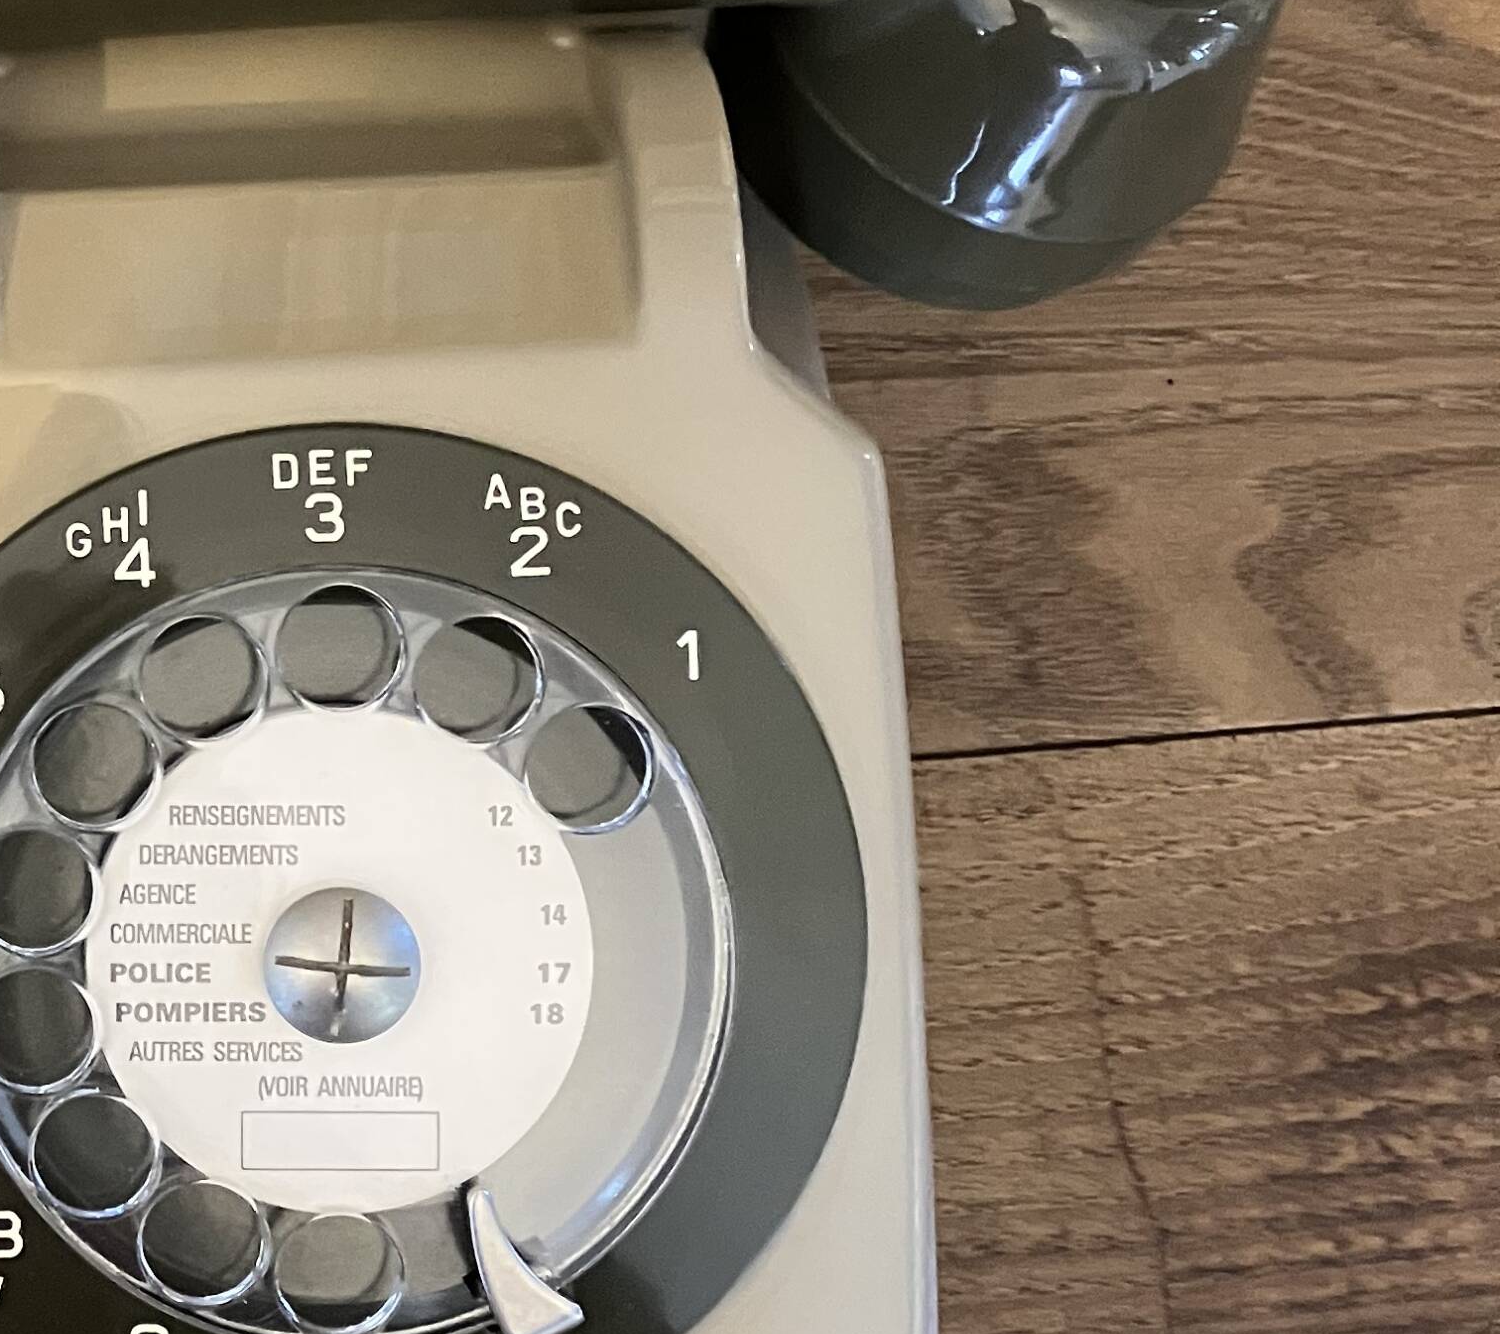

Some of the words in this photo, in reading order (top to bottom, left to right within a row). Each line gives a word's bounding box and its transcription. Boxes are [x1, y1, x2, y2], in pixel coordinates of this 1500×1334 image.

[271, 448, 373, 490] DEF
[304, 492, 346, 543] 3
[113, 537, 157, 589] 4
[508, 525, 552, 578] 2
[675, 629, 700, 681] 1
[168, 803, 346, 828] RENSEIGNEMENTS
[486, 804, 515, 828] 12
[138, 843, 299, 867] DERANGEMENTS
[516, 843, 543, 867] 13
[118, 882, 197, 906] AGENCE
[539, 903, 568, 927] 14
[109, 921, 253, 946] COMMERCIALE
[108, 961, 212, 985] POLICE
[537, 961, 573, 985] 17
[114, 1000, 267, 1024] POMPIERS
[529, 1001, 566, 1025] 18
[128, 1040, 205, 1064] AUTRES
[212, 1040, 304, 1064] SERVICES
[257, 1074, 309, 1103] (VOIR
[316, 1074, 425, 1104] ANNUAIRE)
